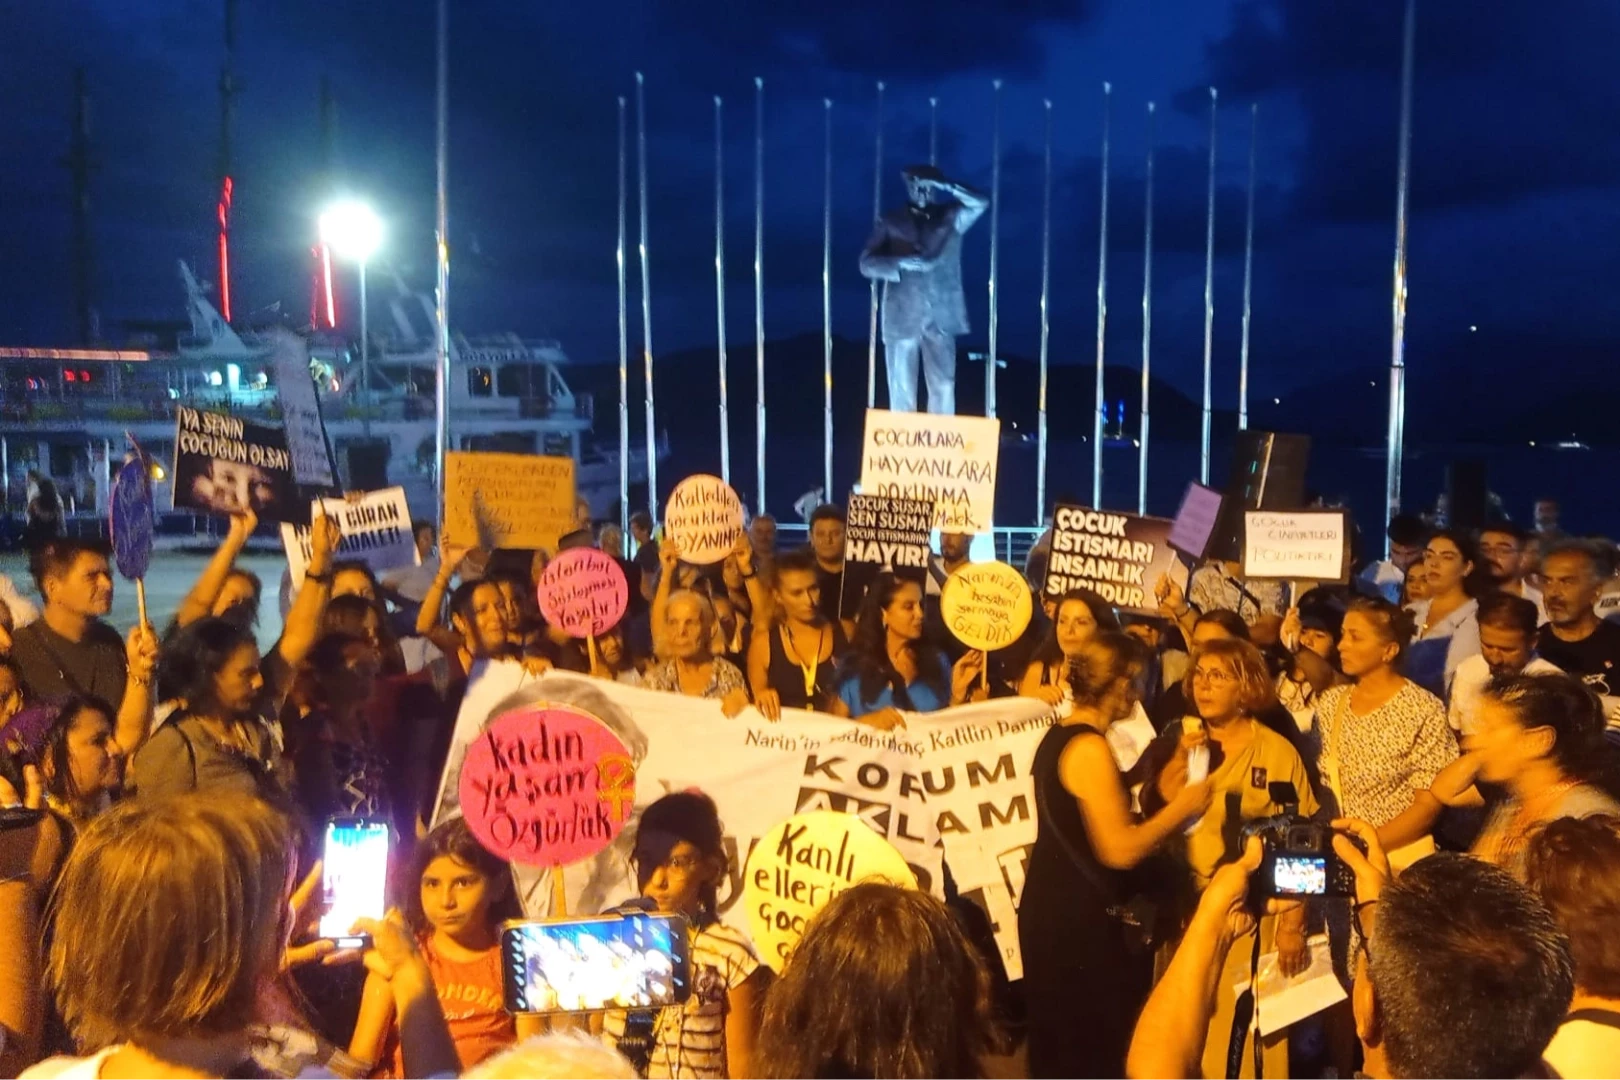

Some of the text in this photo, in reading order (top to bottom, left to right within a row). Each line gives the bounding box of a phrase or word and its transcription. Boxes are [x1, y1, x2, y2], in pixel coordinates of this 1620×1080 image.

[181, 407, 200, 432] YA
[180, 429, 247, 463] ÇOCUĞUN
[869, 455, 993, 485] HAYVANLARA
[877, 482, 971, 508] DOKUNMA
[849, 510, 932, 533] SEN SUSMA!
[1056, 508, 1128, 537] ÇOCUK
[846, 540, 931, 568] HAYIR!
[1053, 529, 1154, 564] İSTİSMARI
[1050, 551, 1145, 585] İNSANLIK
[929, 727, 993, 753] Katilin
[777, 823, 854, 882] Kanlı
